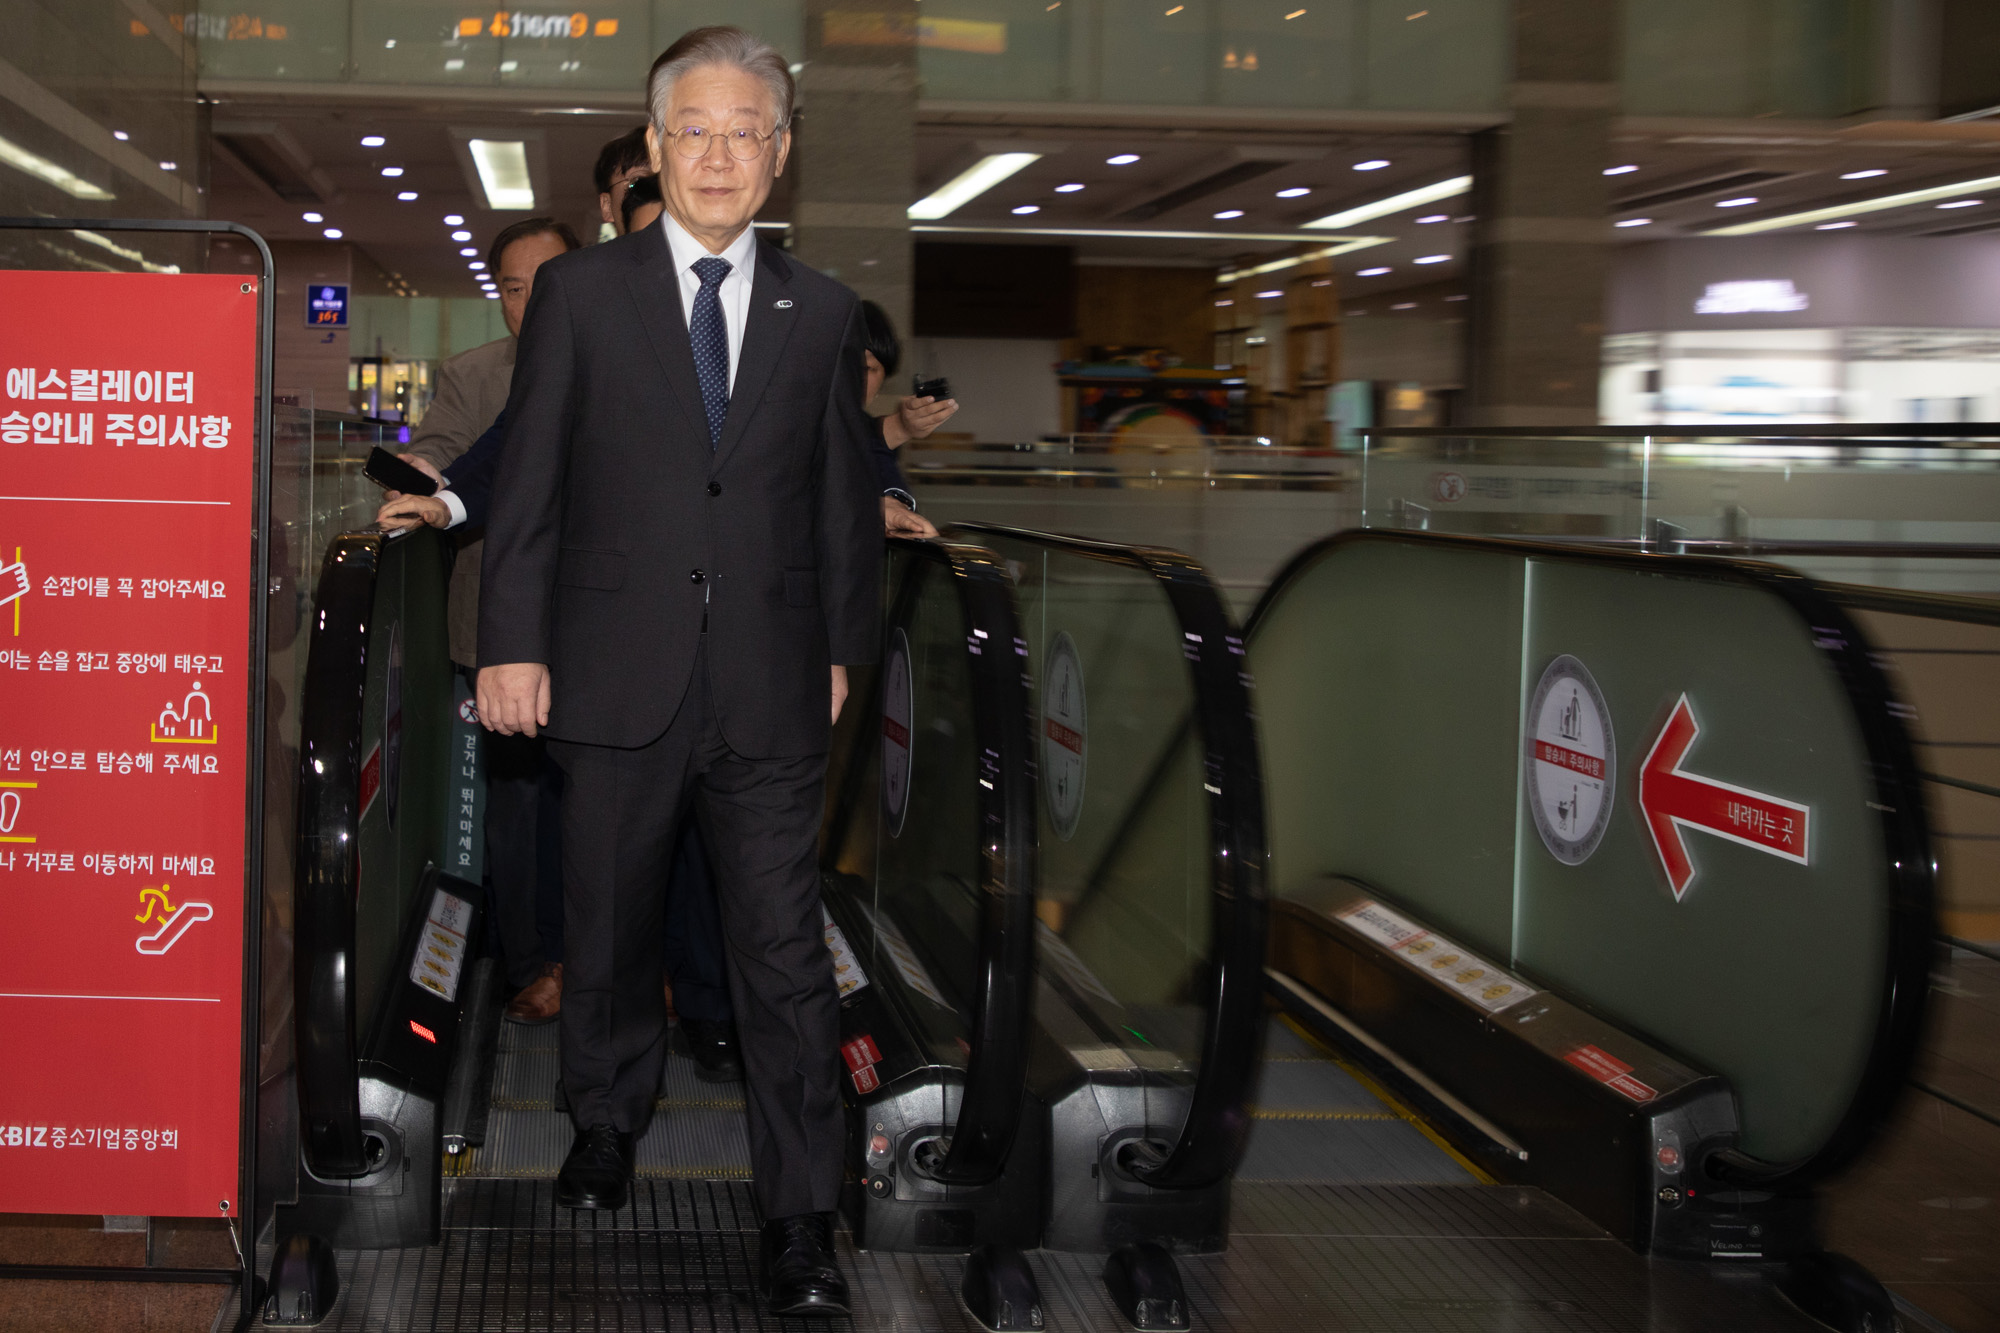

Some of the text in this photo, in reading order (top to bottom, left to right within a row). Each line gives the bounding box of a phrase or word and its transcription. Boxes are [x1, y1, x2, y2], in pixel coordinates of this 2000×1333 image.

[6, 367, 194, 404] 에스컬레이터
[0, 410, 232, 449] 승안내 주의사항
[42, 576, 226, 599] 손잡이를 꼭 잡아주세요
[0, 650, 224, 674] 이는 손을 잡고 중앙에 태우고
[0, 748, 219, 775] 선 안으로 탑승해 주세요
[1570, 753, 1600, 776] 주의사항
[458, 734, 476, 866] 걷거나 뛰지마세요
[1728, 801, 1794, 845] 내려가는 곳
[23, 852, 76, 873] 거꾸로
[82, 853, 154, 876] 이동하지
[162, 855, 216, 876] 마세요
[50, 1127, 178, 1151] 중소기업중앙회
